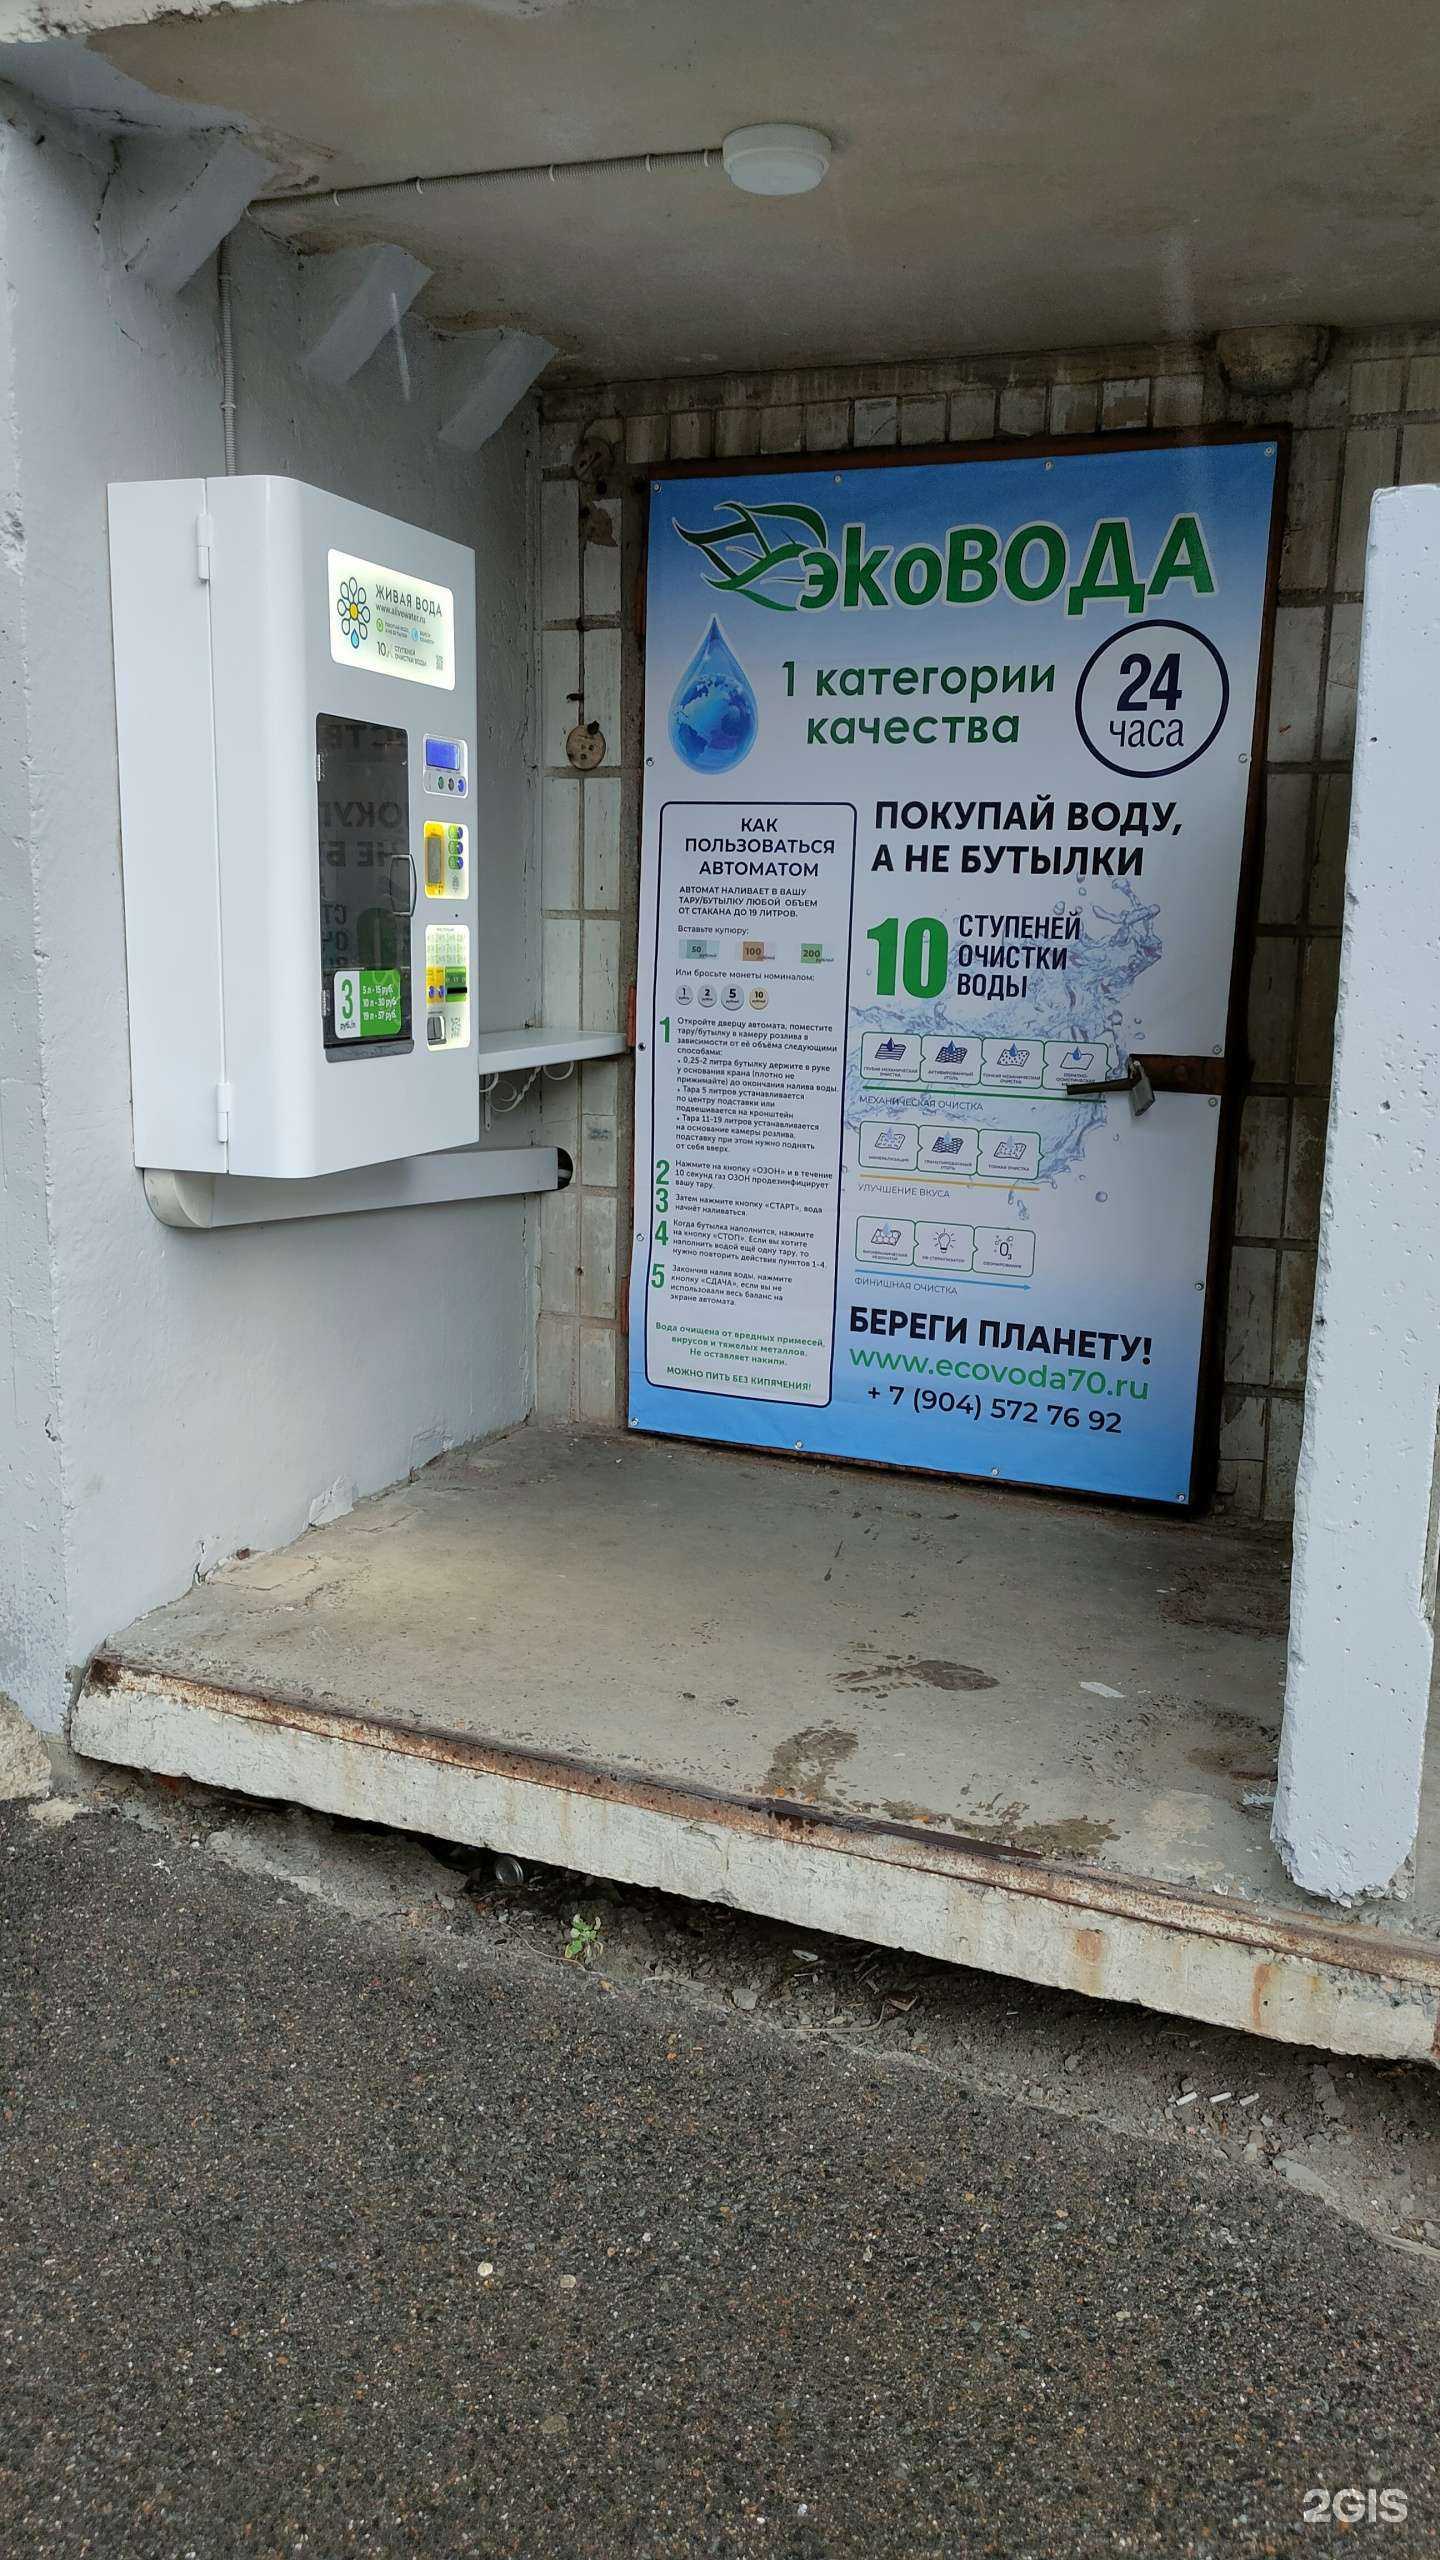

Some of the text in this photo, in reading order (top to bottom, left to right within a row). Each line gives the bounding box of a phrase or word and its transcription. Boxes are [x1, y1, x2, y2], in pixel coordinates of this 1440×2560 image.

[376, 584, 442, 617] ЖИВАЯ ВОДА
[782, 660, 1055, 704] 1 категории
[1116, 652, 1183, 712] 24
[807, 715, 1019, 745] качества
[1109, 718, 1184, 748] часа
[741, 818, 778, 832] КАК
[875, 794, 1182, 837] ПОКУПАЙ ВОДУ,
[685, 838, 835, 854] ПОЛЬЗОВАТЬСЯ
[698, 860, 818, 877] АВТОМАТОМ
[870, 844, 1144, 877] А НЕ БУТЫЛКИ
[678, 895, 744, 905] ТАРУ/БУТЫЛКУ
[745, 897, 781, 906] ЛЮБОЙ
[679, 886, 720, 894] АВТОМАТ
[721, 886, 769, 895] НАЛИВАЕТ
[779, 888, 807, 896] ВАШУ
[678, 906, 690, 914] ОТ
[691, 907, 732, 916] СТАКАНА
[733, 908, 747, 917] ДО
[749, 908, 757, 916] 19
[677, 924, 713, 933] Вставьте
[959, 910, 1081, 941] СТУПЕНЕЙ
[744, 947, 762, 956] 100
[802, 949, 821, 958] 200
[866, 917, 949, 999] 10
[958, 944, 1068, 970] ОЧИСТКИ
[675, 968, 692, 976] Или
[693, 968, 727, 978] бросьте
[682, 987, 686, 996] 1
[704, 988, 710, 997] 2
[728, 988, 736, 998] 5
[754, 990, 764, 999] 10
[957, 973, 1027, 1001] ВОДЫ
[342, 978, 353, 1019] 3
[659, 1016, 670, 1043] 1
[677, 1016, 716, 1027] Откройте
[717, 1020, 746, 1029] дверцу
[789, 1024, 833, 1032] поместите
[677, 1027, 731, 1038] тару/бутылку
[738, 1031, 768, 1041] камеру
[769, 1033, 802, 1041] розлива
[677, 1037, 728, 1046] зависимости
[783, 1043, 837, 1052] следующими
[859, 1095, 984, 1111] МЕХАНИЧЕСКАЯ ОЧИСТКА
[655, 1159, 670, 1185] 2
[675, 1159, 711, 1170] Нажмите
[722, 1164, 751, 1174] кнопку
[801, 1170, 833, 1180] течение
[686, 1171, 713, 1180] секунд
[727, 1173, 750, 1182] ОЗОН
[751, 1175, 828, 1189] продезинфицирует
[655, 1187, 669, 1213] 3
[858, 1183, 951, 1199] УЛУЧШЕНИЕ ВКУСА
[675, 1193, 698, 1202] Затем
[699, 1197, 733, 1206] нажмите
[734, 1200, 763, 1210] кнопку
[654, 1220, 669, 1246] 4
[673, 1218, 695, 1228] Когда
[696, 1221, 728, 1230] бутылка
[778, 1230, 814, 1239] нажмите
[683, 1230, 711, 1240] кнопку
[748, 1234, 767, 1244] Если
[780, 1239, 808, 1248] хотите
[651, 1263, 664, 1288] 5
[671, 1275, 699, 1285] кнопку
[672, 1264, 708, 1274] Закончив
[709, 1269, 732, 1277] налив
[757, 1275, 792, 1283] нажмите
[854, 1276, 958, 1297] ФИНИШНАЯ ОЧИСТКА
[655, 1321, 678, 1332] Вода
[679, 1326, 720, 1336] очищена
[734, 1332, 775, 1342] вредных
[671, 1336, 708, 1346] вирусов
[850, 1305, 1152, 1366] БЕРЕГИ ПЛАНЕТУ!
[689, 1347, 702, 1356] Не
[703, 1351, 749, 1361] оставляет
[666, 1366, 811, 1391] МОЖНО ПИТЬ БЕЗ КИПЯЧЕНИЯ!
[849, 1348, 1151, 1400] www.ecovoda70.ru
[889, 1385, 904, 1405] 7
[913, 1388, 981, 1421] (904)
[990, 1398, 1038, 1423] 572
[1047, 1404, 1080, 1432] 76
[1088, 1410, 1122, 1434] 92
